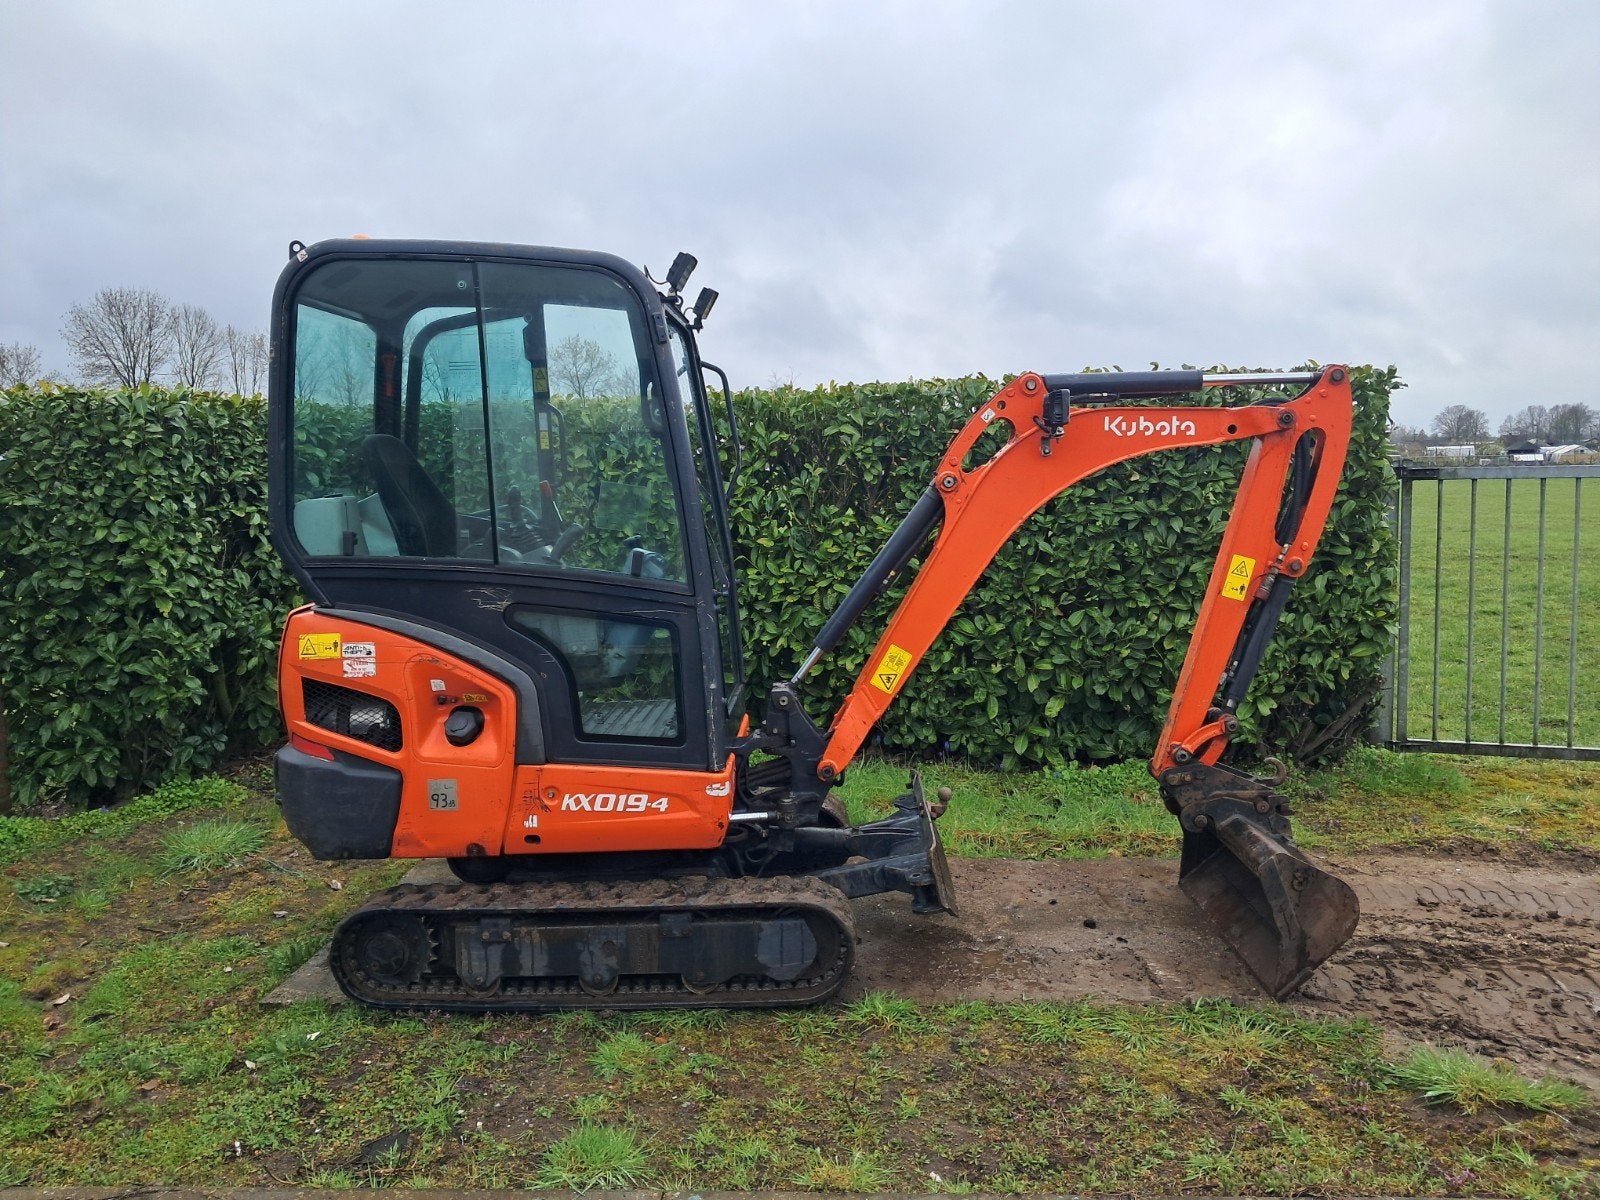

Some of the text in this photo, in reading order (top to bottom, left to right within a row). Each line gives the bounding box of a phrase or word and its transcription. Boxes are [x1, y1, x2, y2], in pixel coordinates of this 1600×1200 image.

[1104, 416, 1196, 436] Kubota
[431, 793, 448, 808] 93
[561, 793, 669, 812] KX019-4
